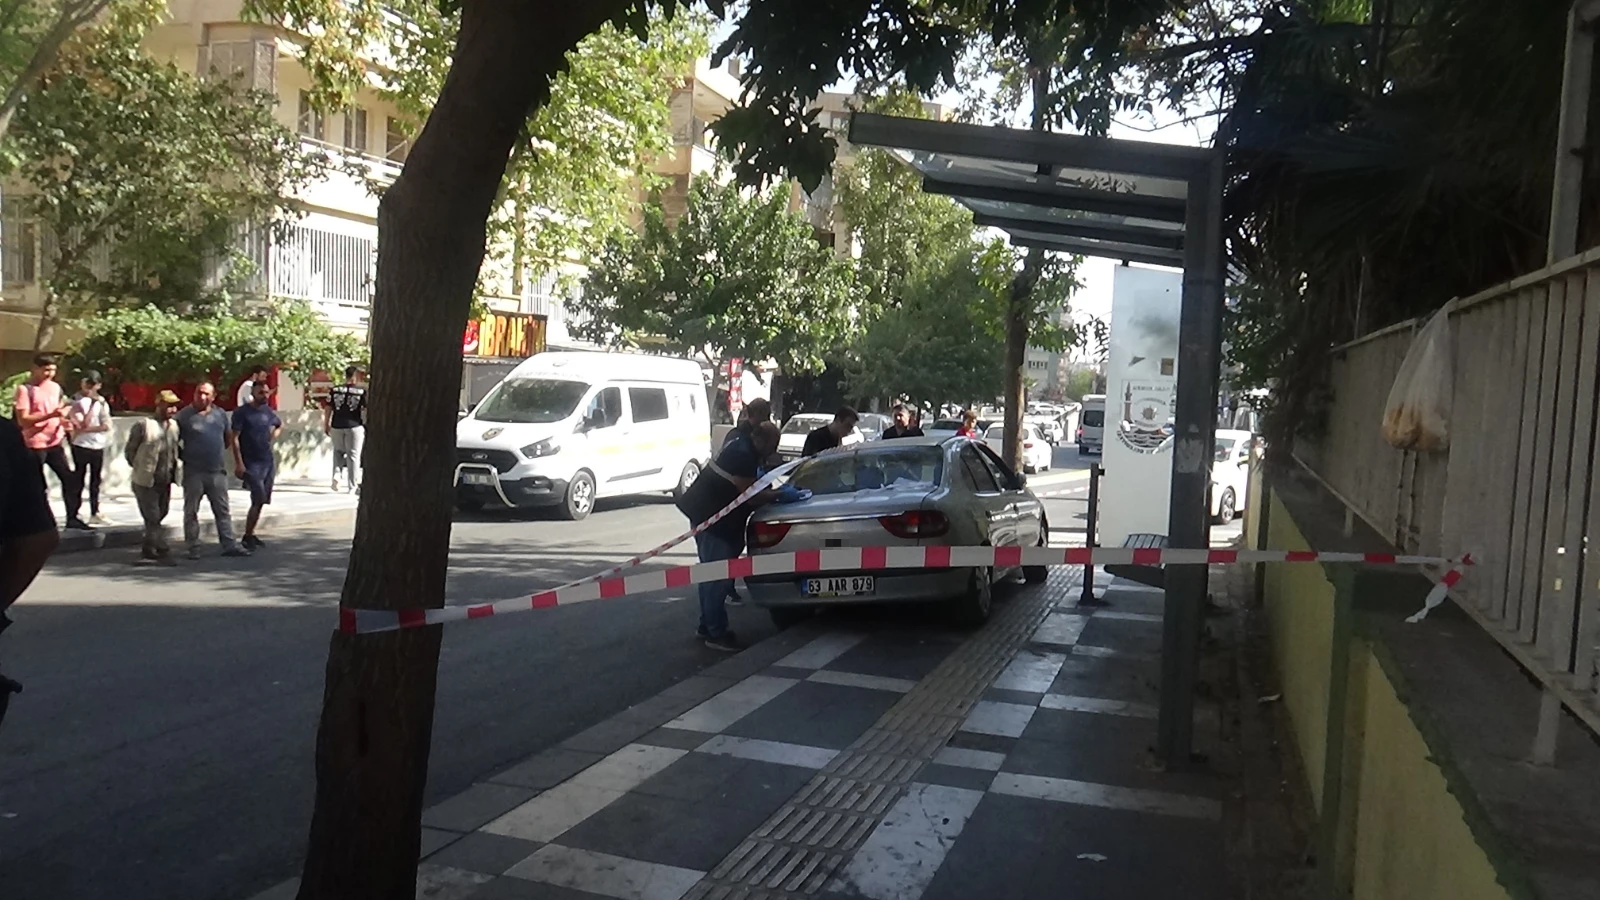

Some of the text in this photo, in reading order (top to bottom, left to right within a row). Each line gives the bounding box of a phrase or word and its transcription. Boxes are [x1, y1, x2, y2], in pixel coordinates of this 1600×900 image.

[808, 577, 873, 592] 63 AAR 879
